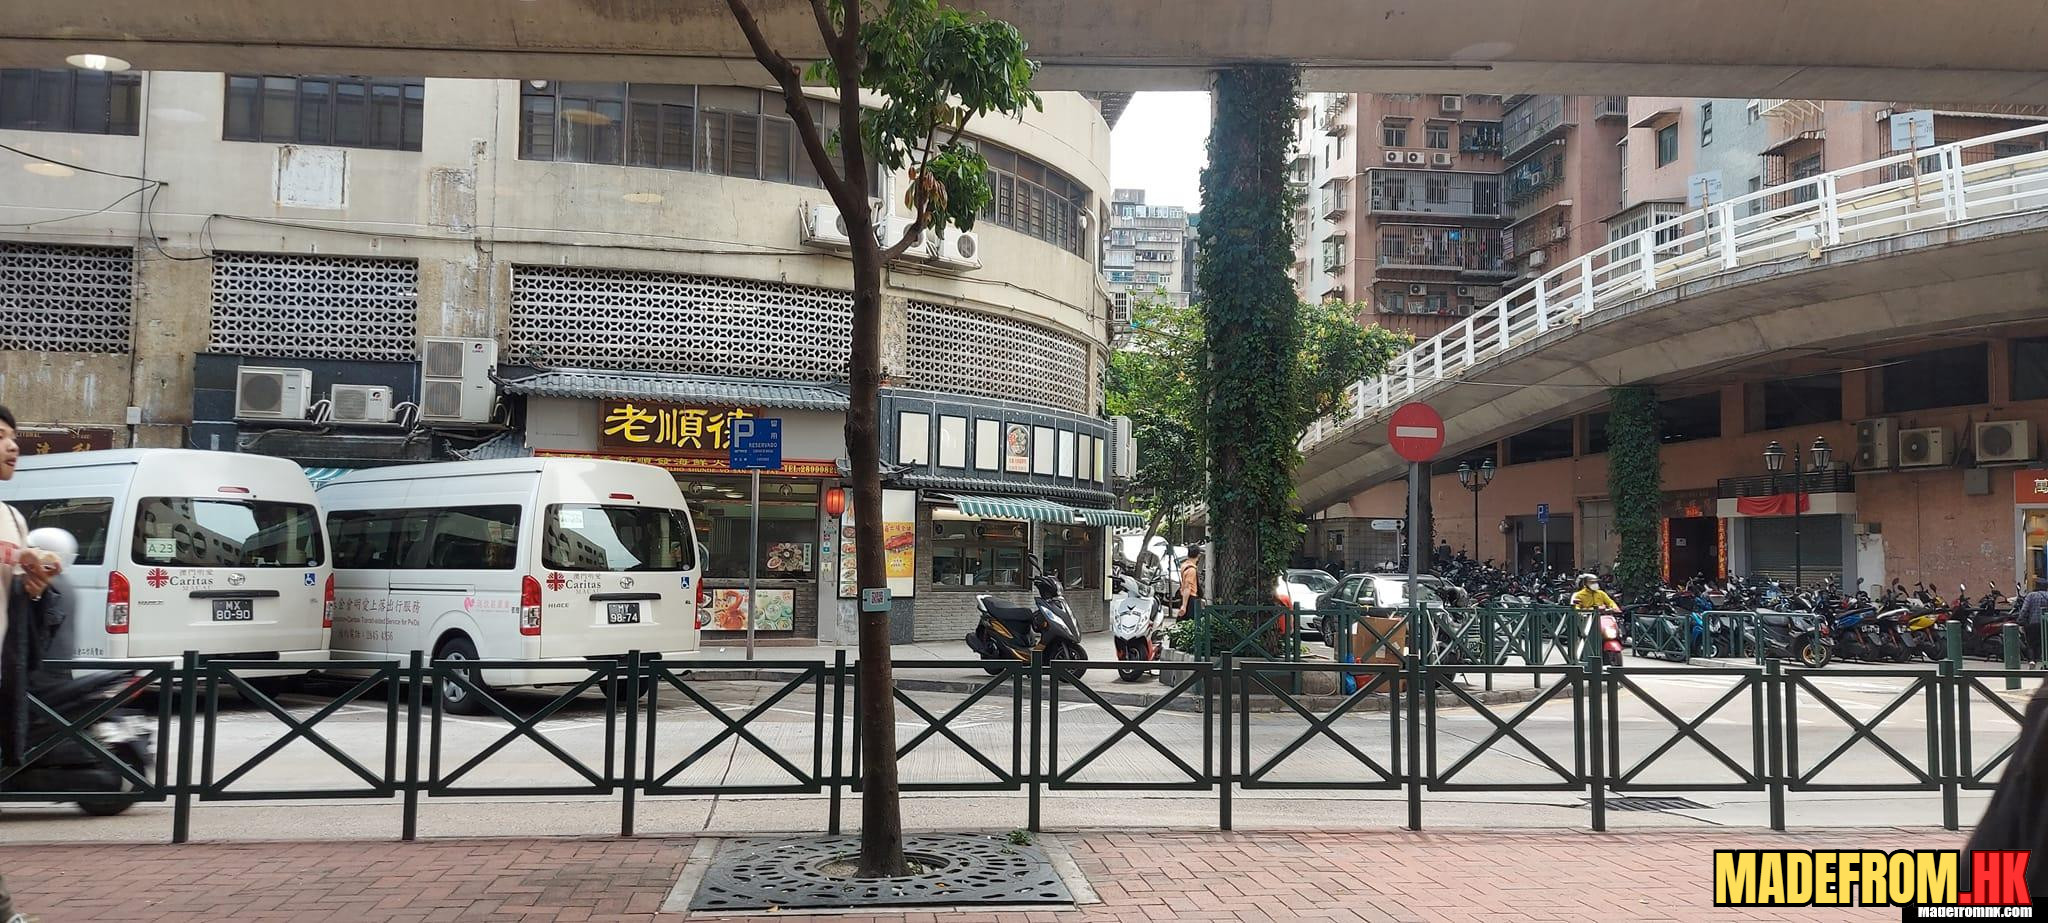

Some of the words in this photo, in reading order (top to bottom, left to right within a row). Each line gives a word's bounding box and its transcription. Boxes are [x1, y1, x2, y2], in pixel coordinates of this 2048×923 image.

[734, 420, 754, 448] P
[148, 543, 157, 553] A
[159, 543, 174, 553] 23
[169, 576, 214, 586] Caritas
[565, 579, 602, 589] Caritas
[225, 601, 241, 610] MX
[618, 604, 630, 612] MY
[216, 610, 250, 620] 80-90
[610, 613, 638, 622] 98-74
